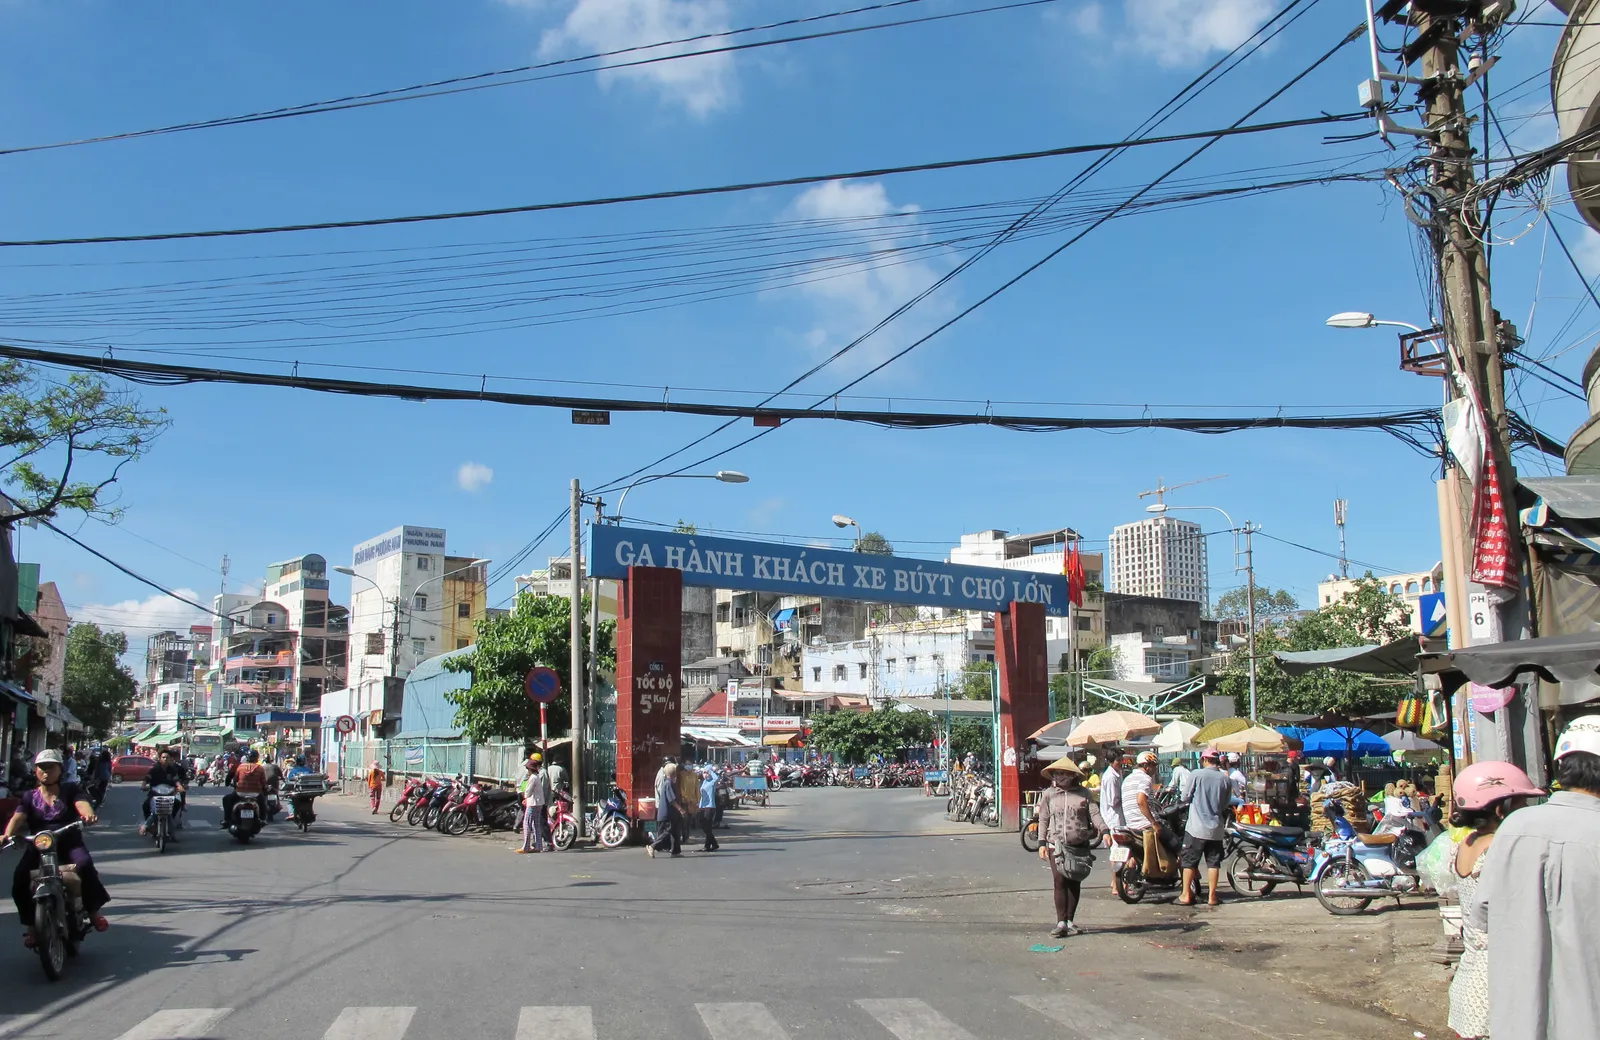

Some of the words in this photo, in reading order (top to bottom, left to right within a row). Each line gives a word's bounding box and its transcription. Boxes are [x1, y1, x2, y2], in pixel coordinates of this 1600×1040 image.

[615, 540, 655, 568] GA
[664, 540, 744, 577] HÀNH
[752, 551, 845, 587] KHÁCH
[853, 565, 887, 590] XE
[894, 565, 954, 597] BÚYT
[961, 576, 1005, 606] CHỢ
[1013, 574, 1053, 605] LỚN
[1471, 595, 1485, 603] PH
[1474, 612, 1485, 626] 6
[636, 671, 655, 690] TỐC
[658, 673, 674, 693] ĐỘ
